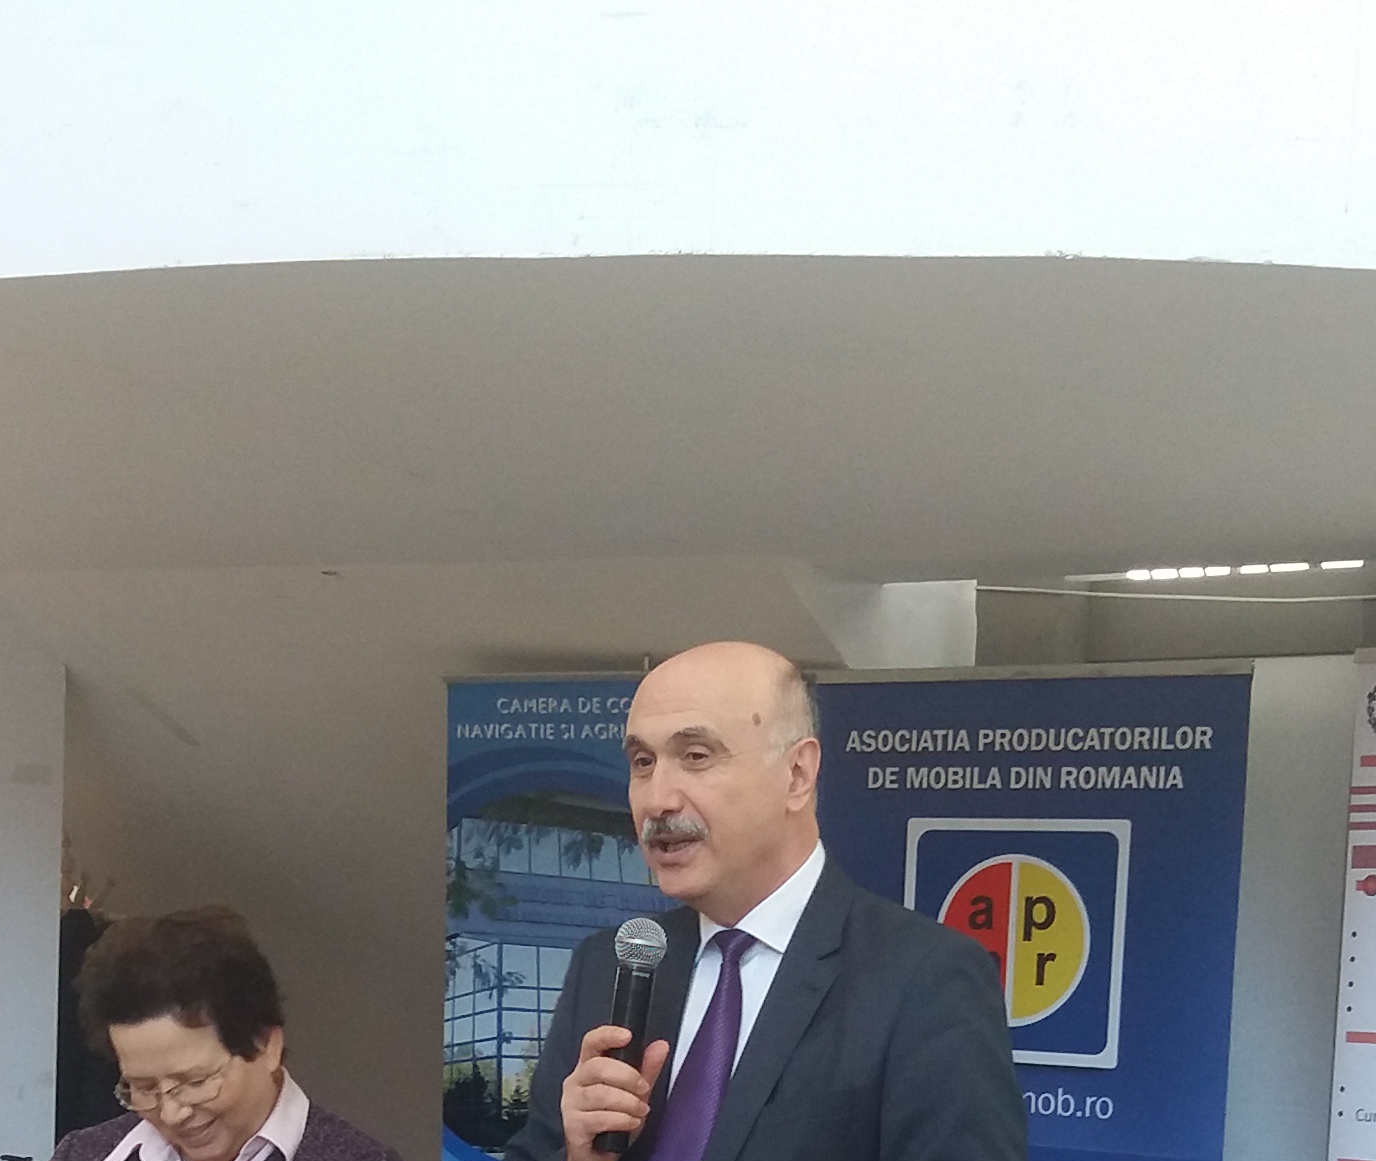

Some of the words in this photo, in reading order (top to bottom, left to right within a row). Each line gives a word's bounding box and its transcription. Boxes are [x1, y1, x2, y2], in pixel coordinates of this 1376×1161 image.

[497, 697, 572, 714] CAMERA
[578, 697, 601, 714] DE
[606, 697, 631, 713] CO
[457, 723, 555, 740] NAVIGATIE
[580, 721, 628, 742] AGRI
[845, 729, 970, 752] ASOCIATIA
[978, 725, 1213, 751] PRODUCATORILOR
[867, 767, 900, 789] DE
[906, 766, 1002, 789] MOBILA
[1009, 766, 1052, 789] DIN
[1060, 766, 1184, 789] ROMANIA
[968, 894, 994, 930] a
[1024, 894, 1056, 942] p
[1035, 951, 1057, 987] r
